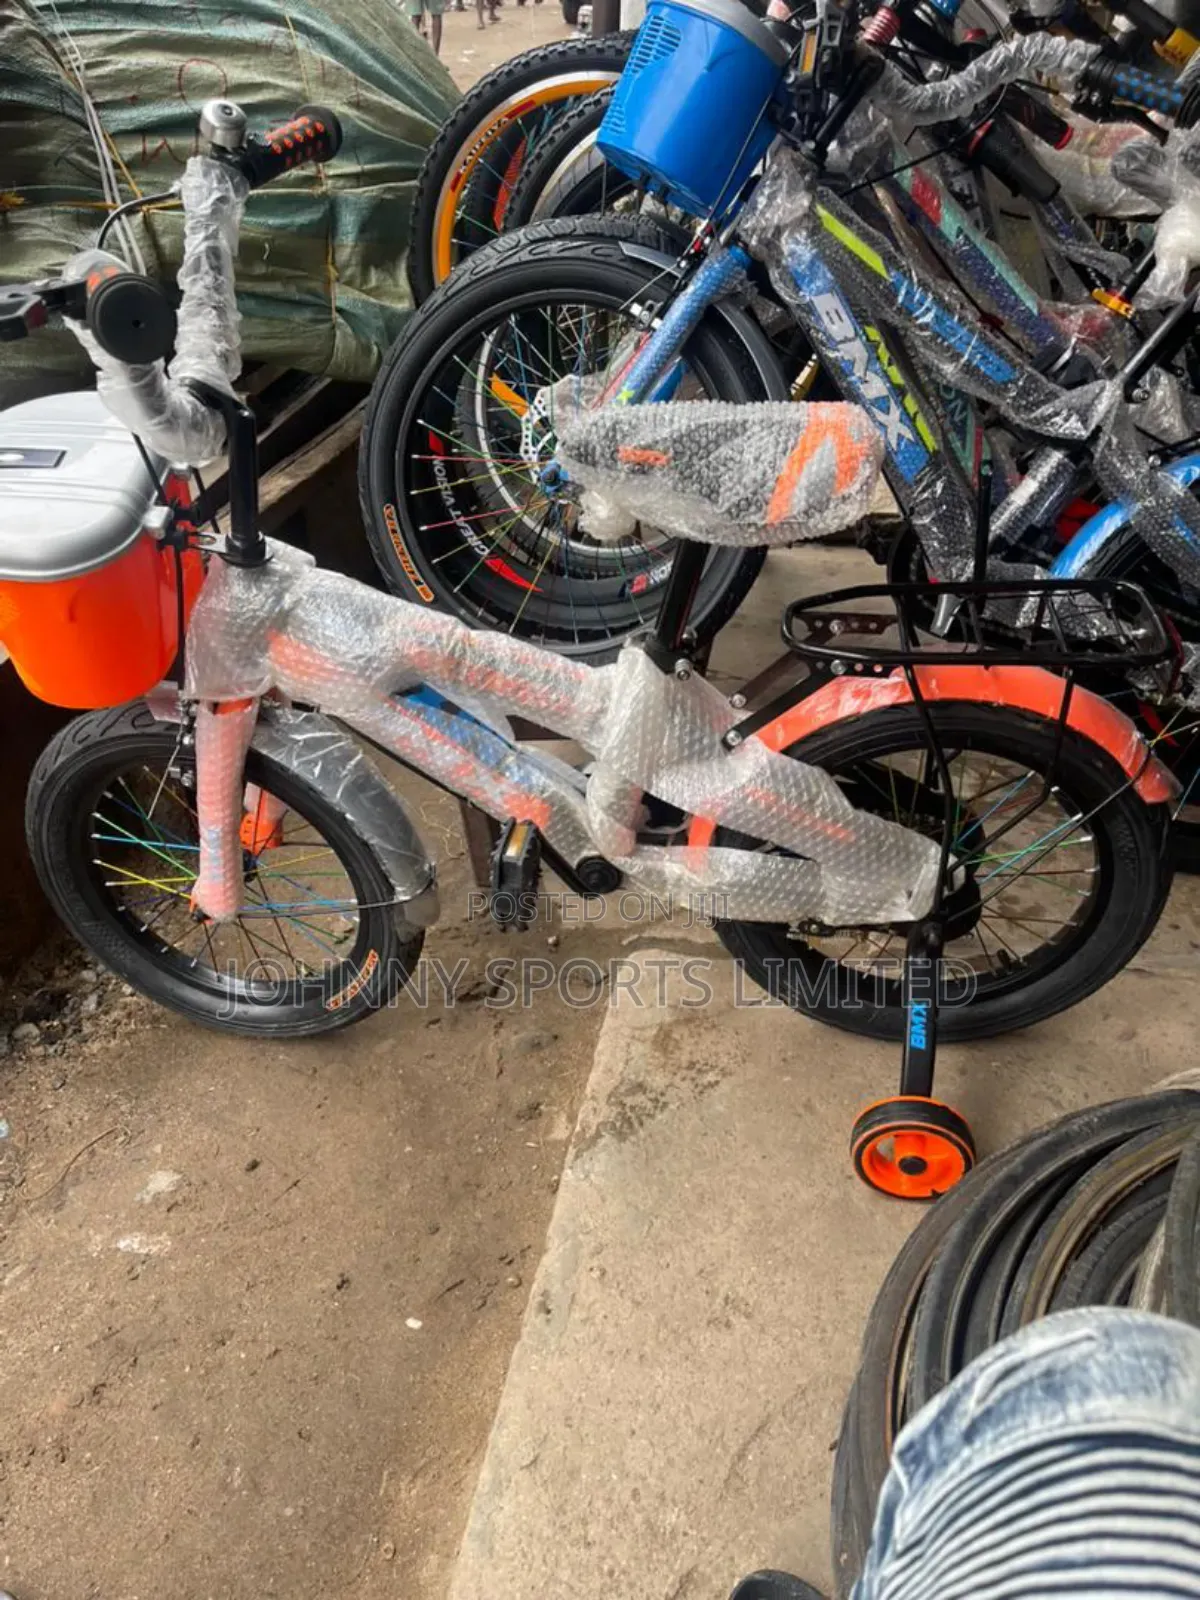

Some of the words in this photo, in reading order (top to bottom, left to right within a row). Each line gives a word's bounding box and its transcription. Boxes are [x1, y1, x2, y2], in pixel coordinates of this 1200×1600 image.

[810, 293, 915, 451] BMX
[450, 508, 490, 556] GREAT
[909, 1001, 927, 1050] BMX
